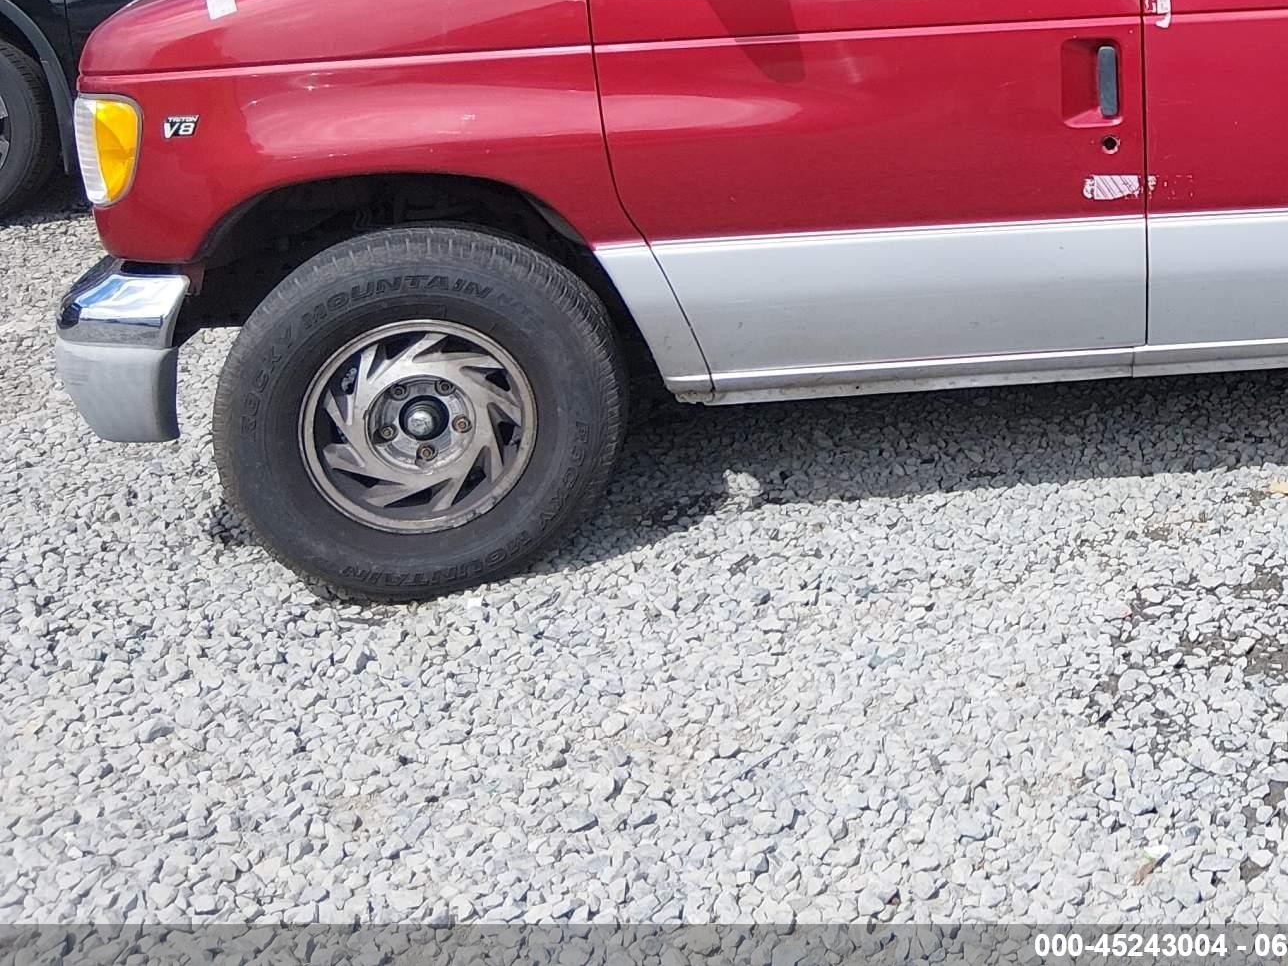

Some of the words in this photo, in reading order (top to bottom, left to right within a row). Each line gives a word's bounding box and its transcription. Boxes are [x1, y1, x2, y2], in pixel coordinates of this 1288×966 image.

[168, 115, 199, 123] TRITON
[164, 123, 195, 138] V8
[302, 274, 492, 331] MOUNTAIN
